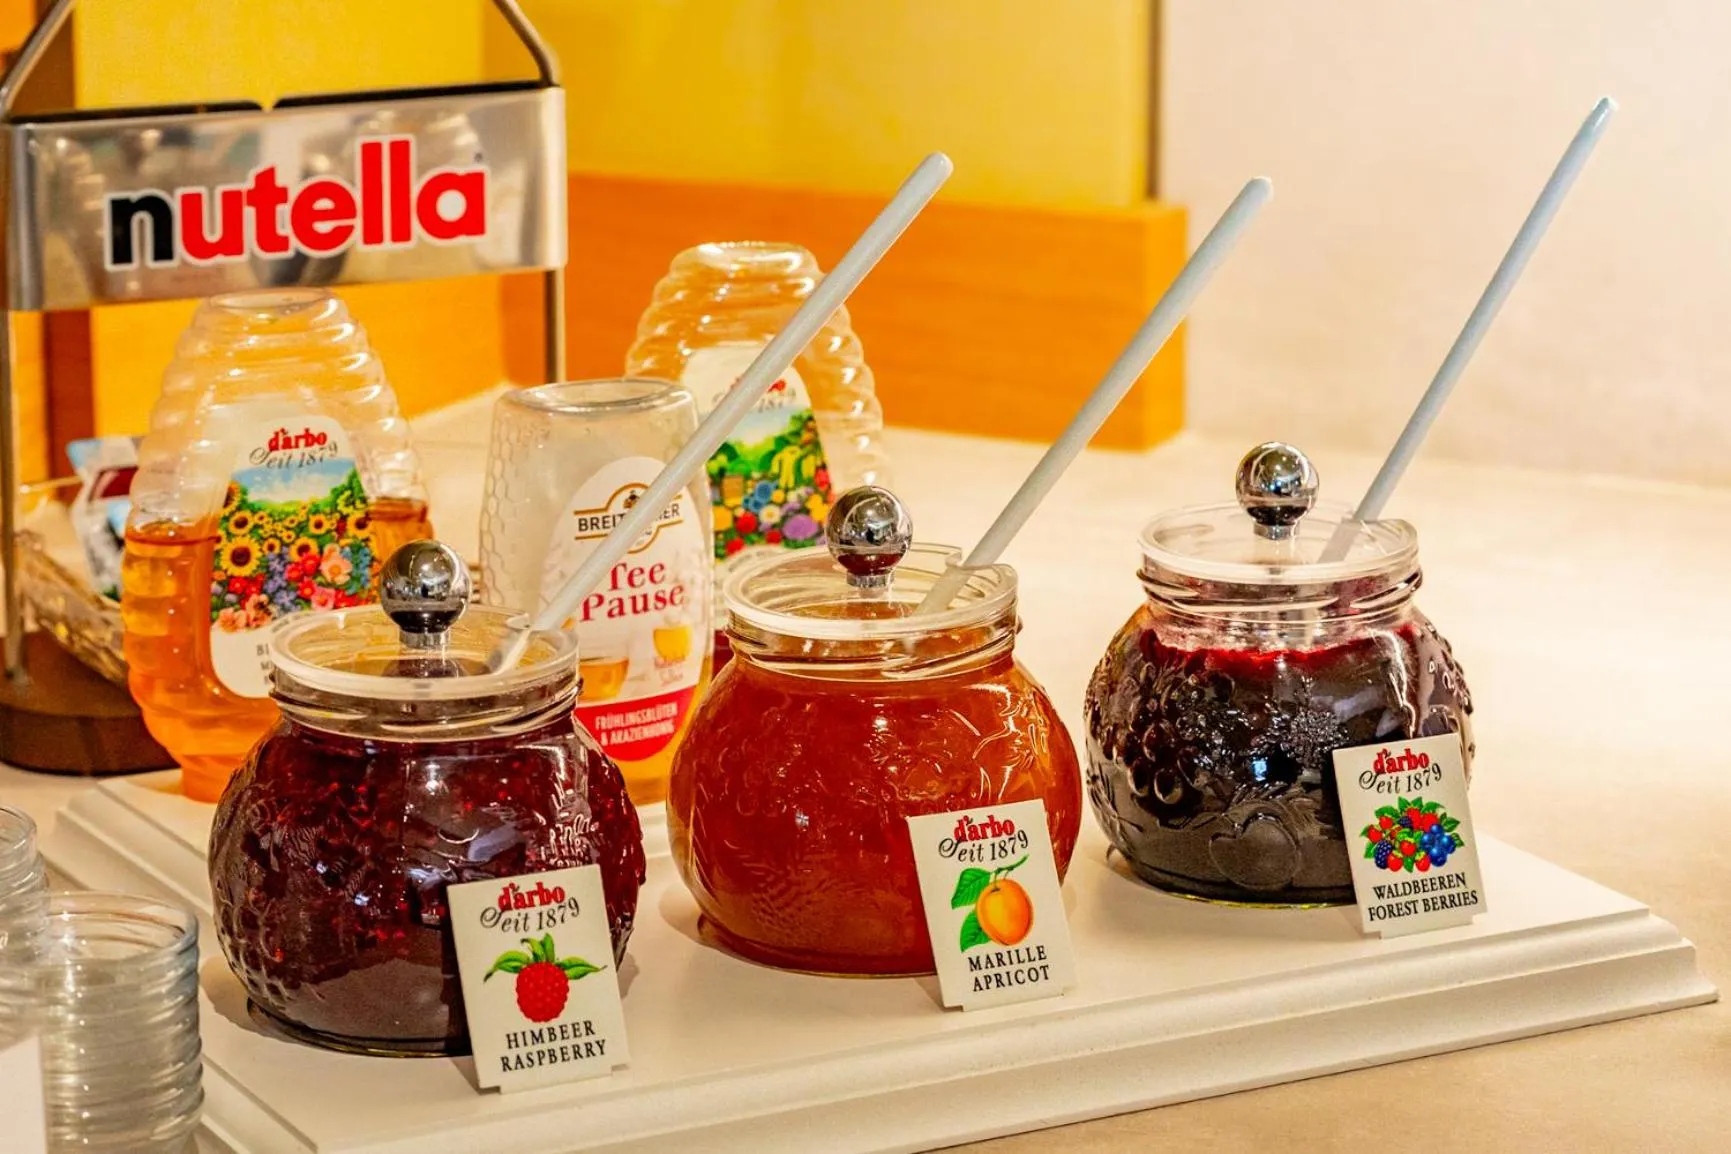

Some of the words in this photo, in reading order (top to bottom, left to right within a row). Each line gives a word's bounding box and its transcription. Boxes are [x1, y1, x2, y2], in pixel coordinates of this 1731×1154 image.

[107, 137, 488, 267] nutella
[249, 446, 292, 469] Seit
[298, 440, 338, 468] 1879
[608, 561, 666, 591] Tee
[580, 584, 685, 622] Pause
[600, 731, 609, 746] &
[1358, 770, 1401, 794] Seit
[1407, 763, 1442, 793] 1879
[938, 837, 984, 862] Seit
[990, 830, 1029, 861] 1879
[1372, 872, 1467, 901] WALDBEEREN
[480, 906, 530, 933] Seit
[537, 896, 580, 931] 1879
[1368, 900, 1421, 922] FOREST
[1423, 890, 1479, 913] BERRIES
[968, 945, 1048, 972] MARILLE
[973, 965, 1050, 992] APRICOT
[506, 1020, 596, 1049] HIMBEER
[500, 1039, 607, 1072] RASPBERRY
